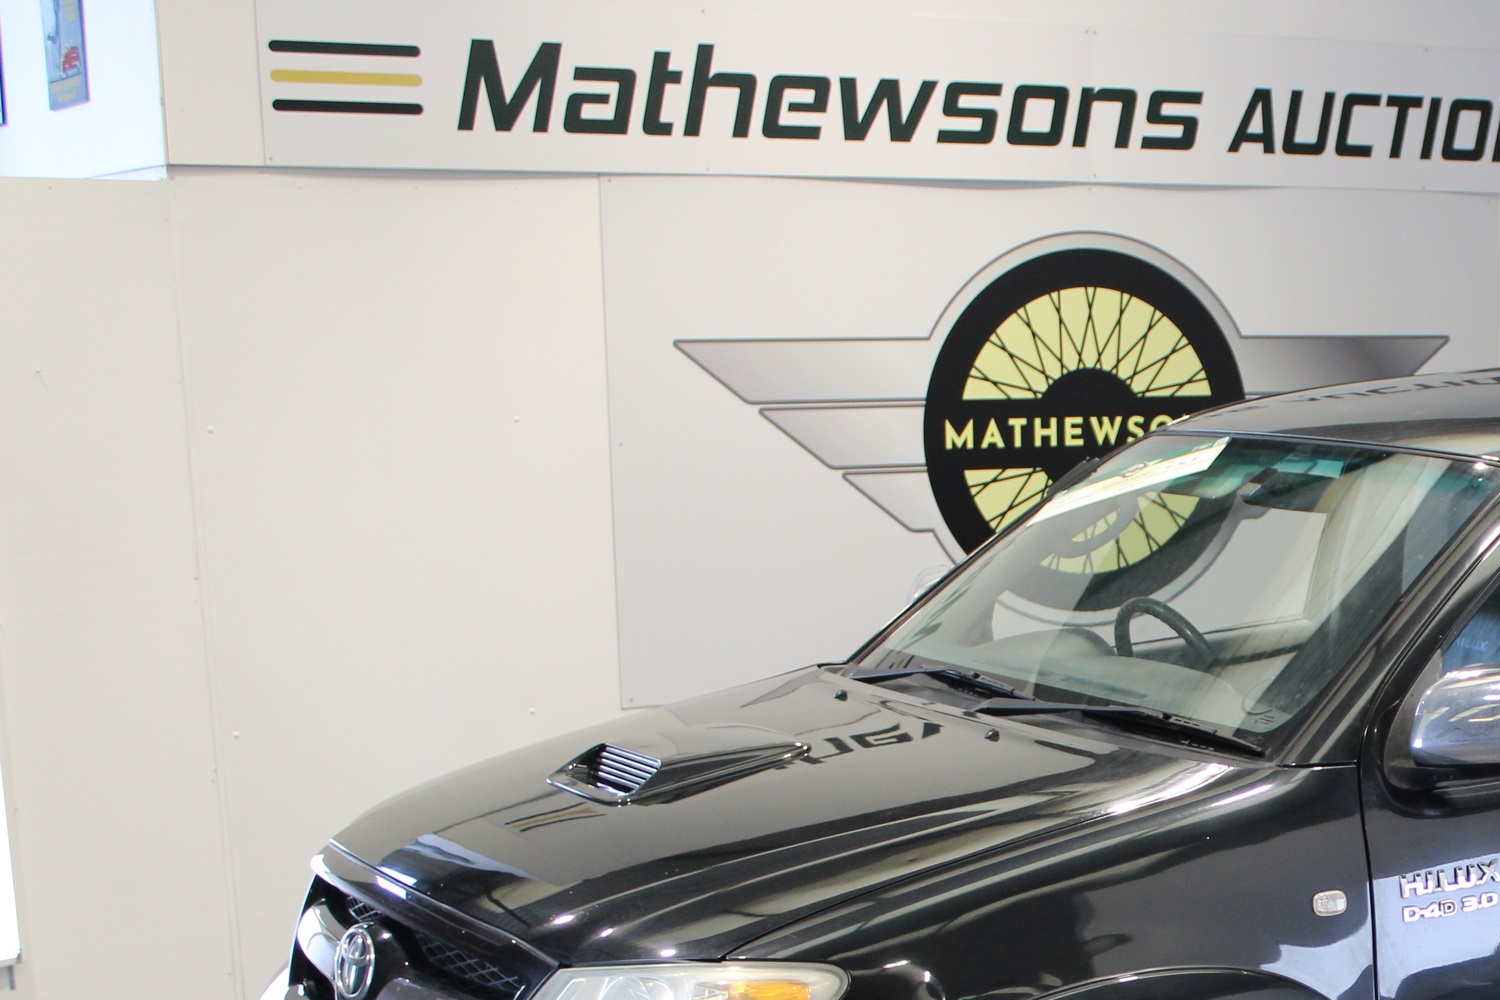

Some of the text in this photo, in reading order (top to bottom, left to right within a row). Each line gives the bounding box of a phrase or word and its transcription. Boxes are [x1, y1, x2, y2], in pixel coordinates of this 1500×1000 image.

[457, 39, 1204, 151] Mathewsons
[1402, 891, 1499, 923] D-4D 3.0
